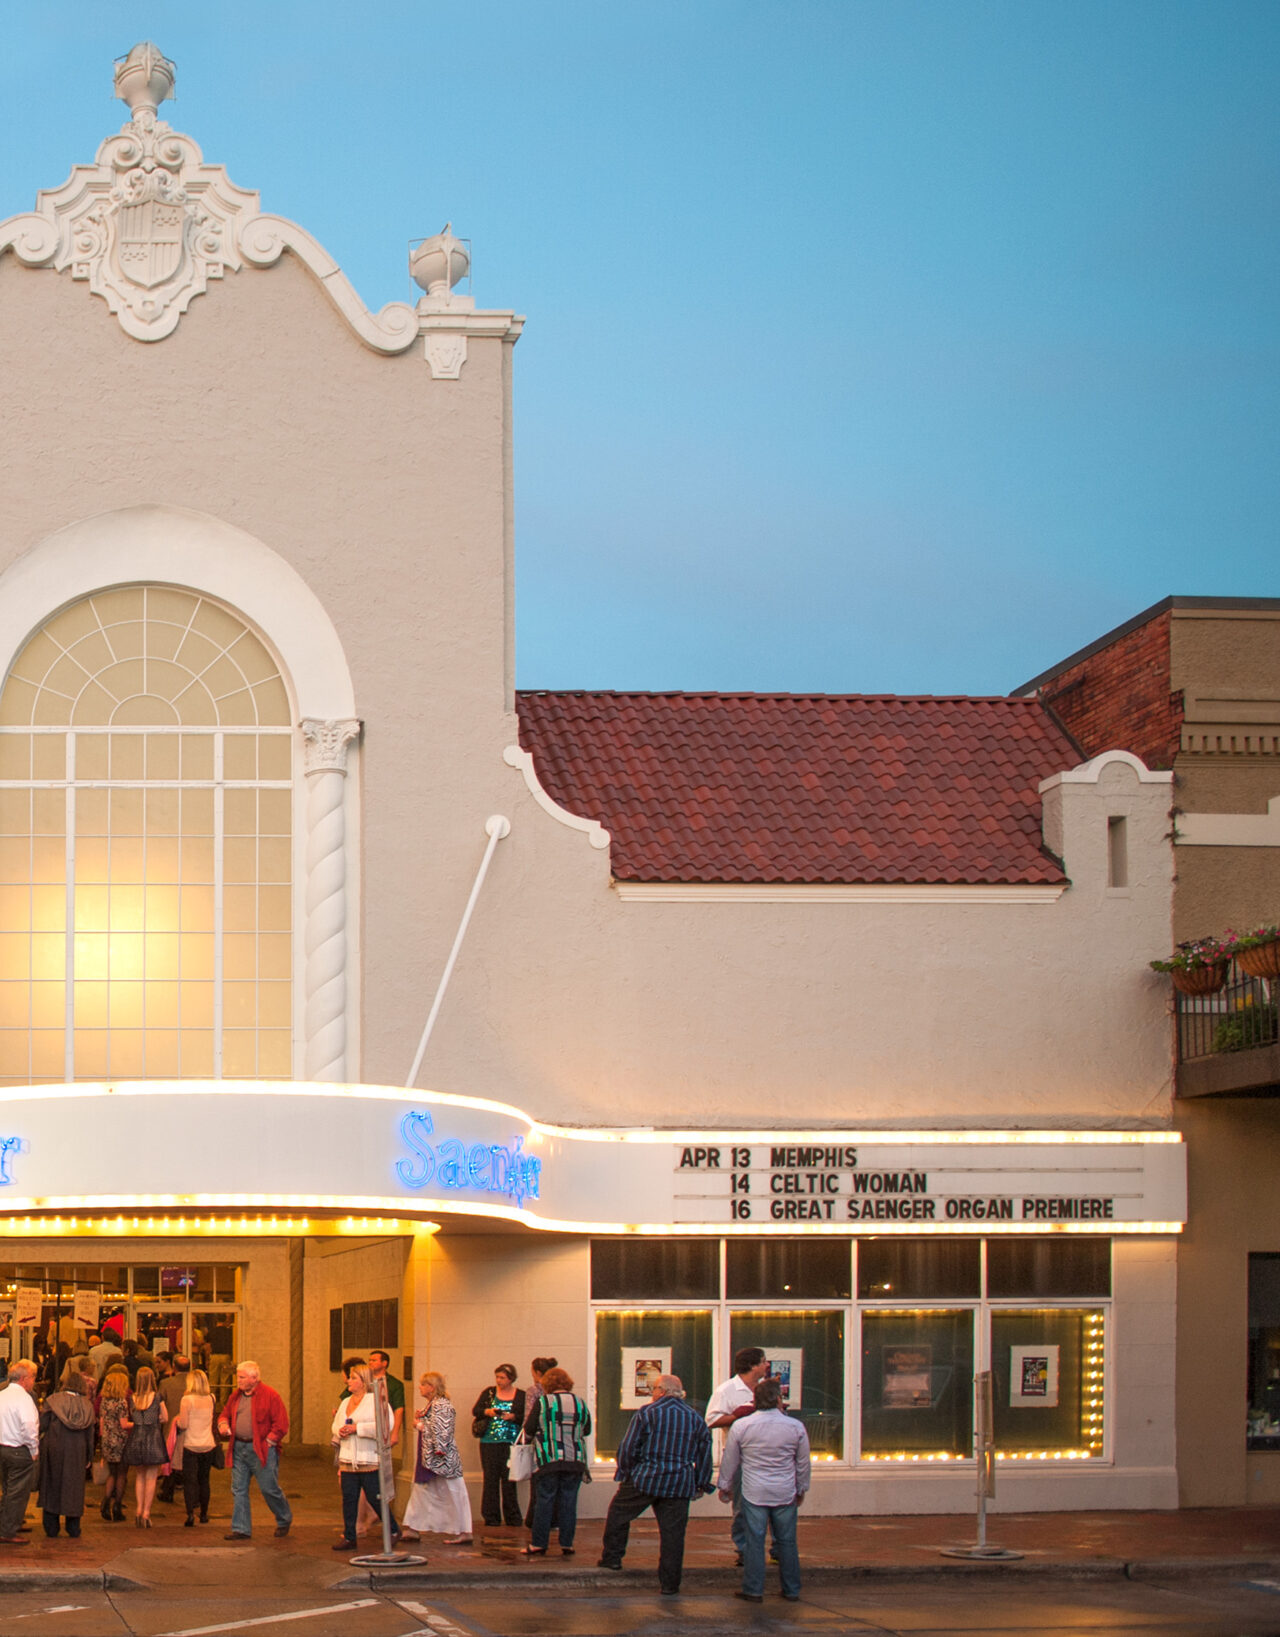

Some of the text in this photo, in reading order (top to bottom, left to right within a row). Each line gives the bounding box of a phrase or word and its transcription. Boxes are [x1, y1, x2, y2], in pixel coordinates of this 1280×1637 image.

[679, 1147, 858, 1168] APR 13 MEMPHIS
[730, 1173, 927, 1194] 14 CELTIC WOMAN
[730, 1199, 1114, 1220] 16 GREAT SAENGER ORGAN PREMIERE
